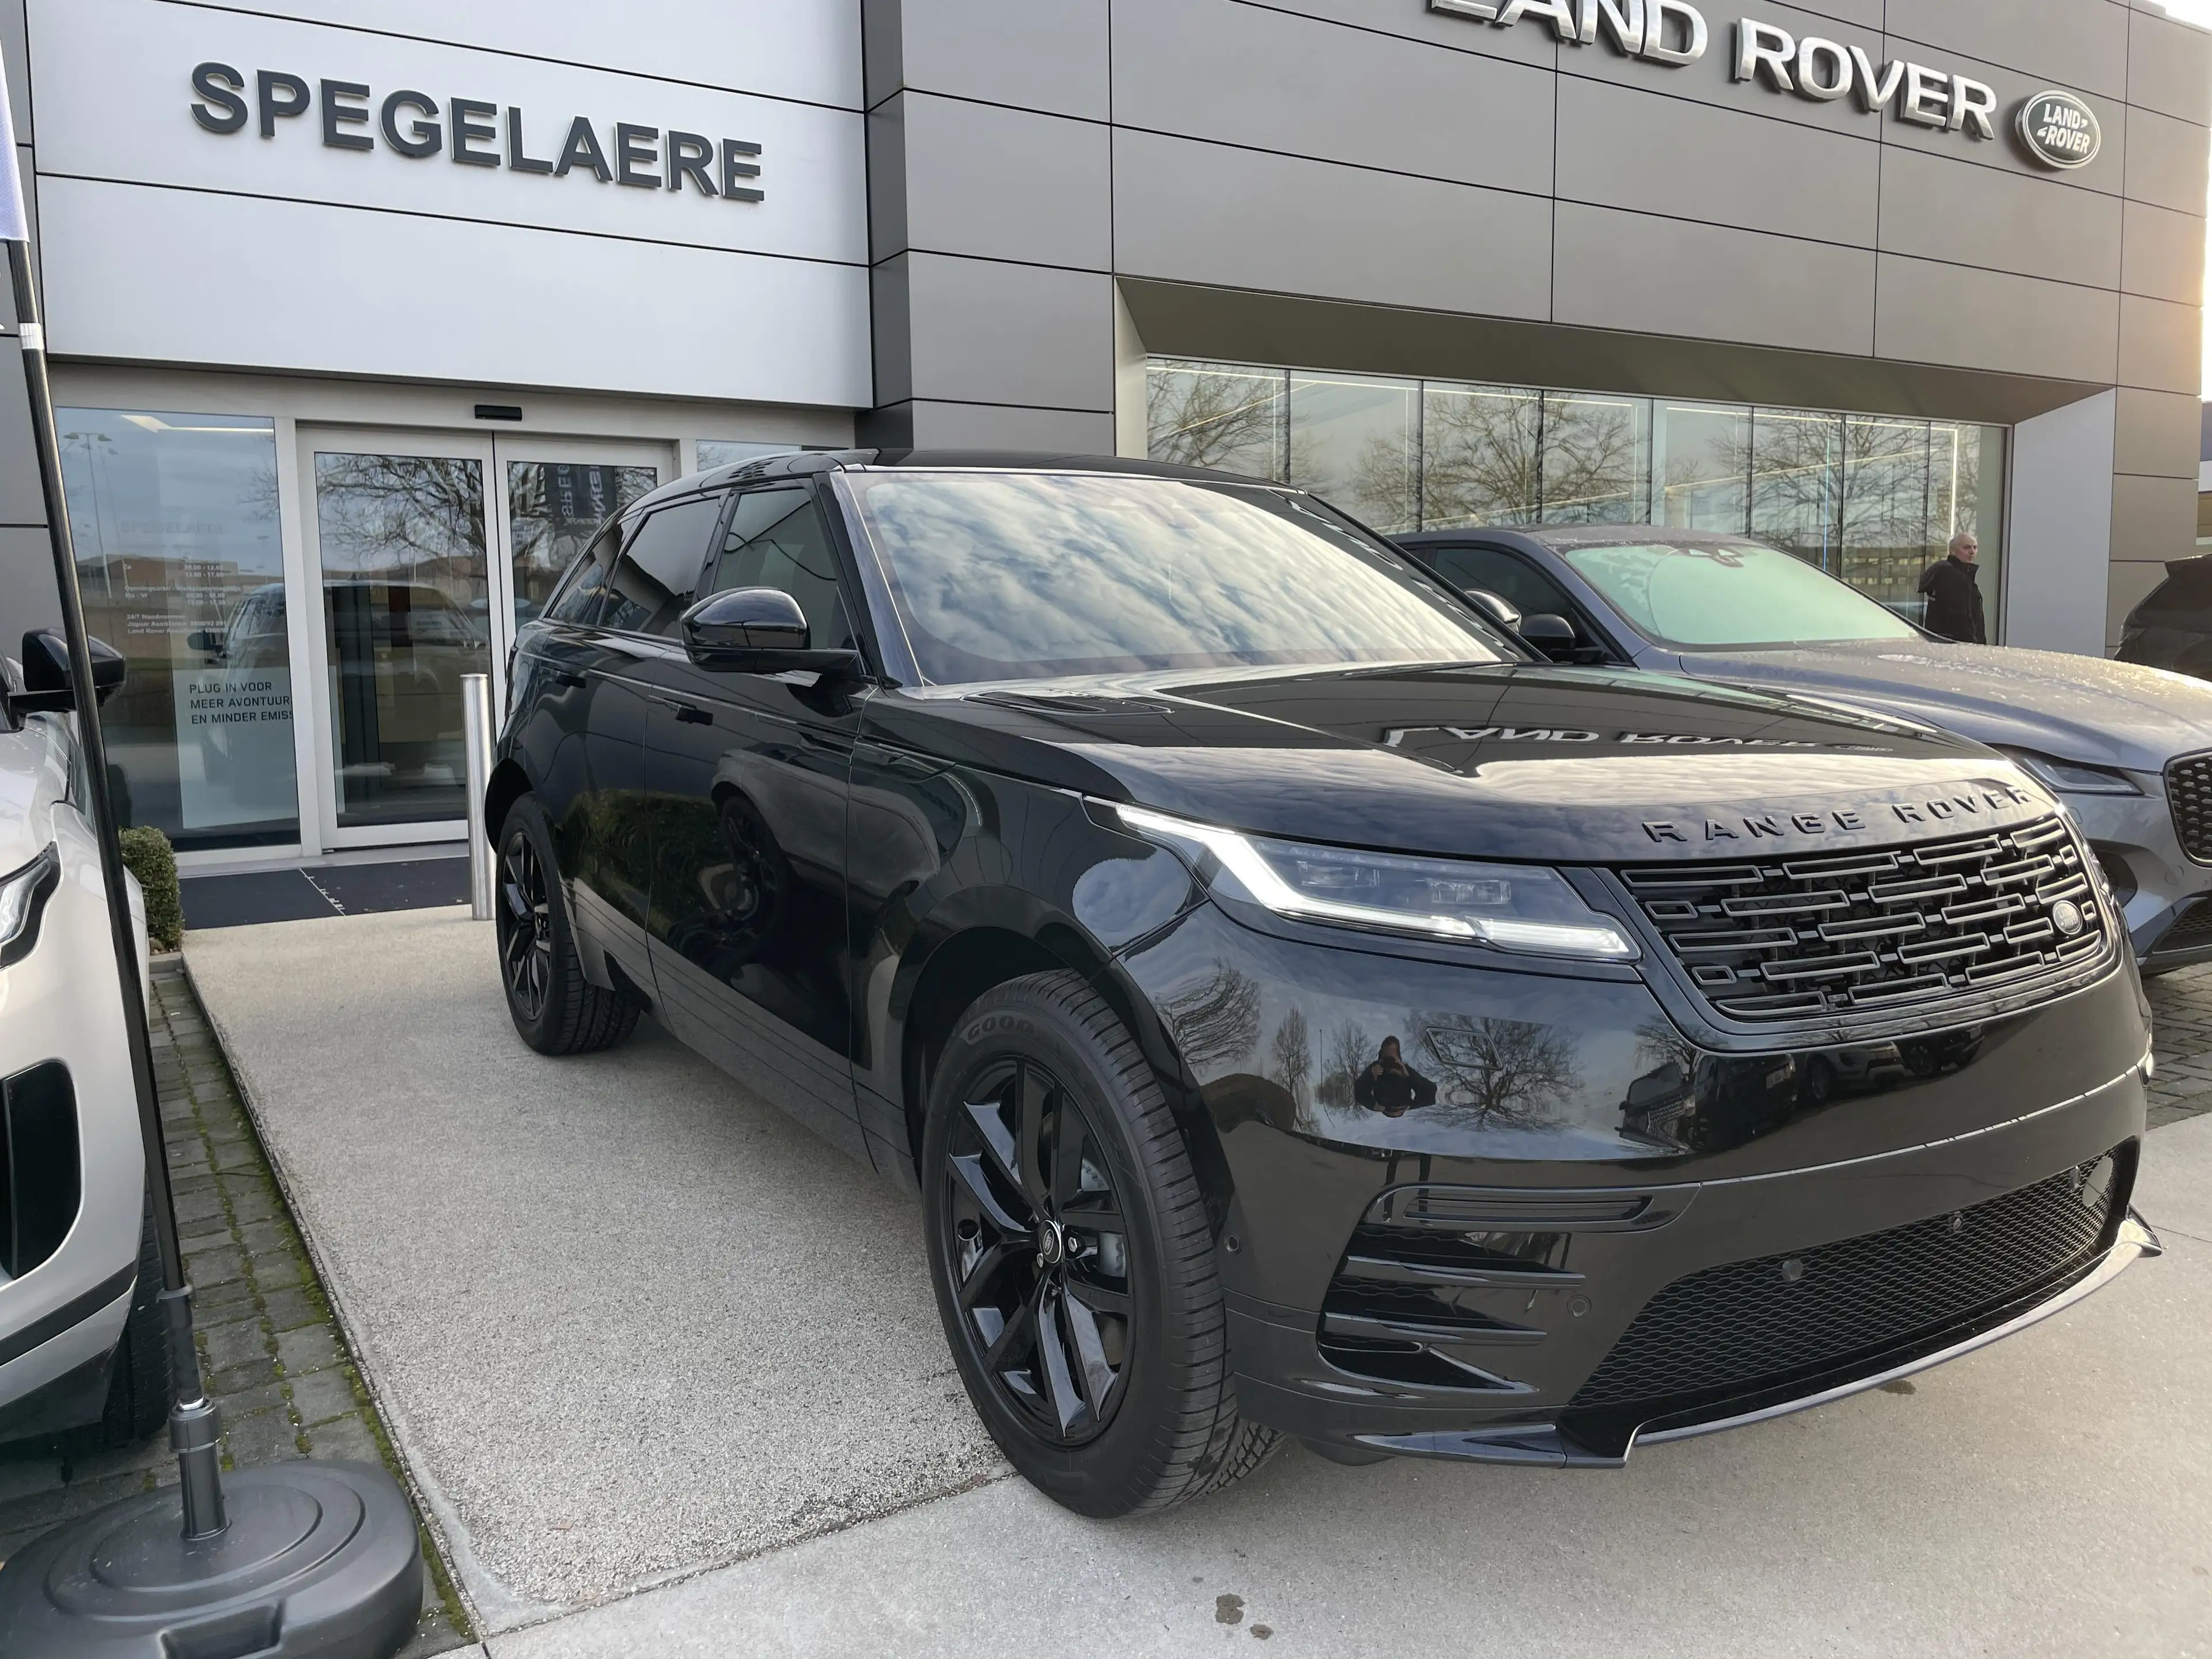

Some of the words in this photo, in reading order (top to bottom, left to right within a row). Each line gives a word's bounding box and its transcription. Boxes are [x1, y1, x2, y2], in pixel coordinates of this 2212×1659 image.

[1735, 17, 1997, 141] ROVER
[2043, 103, 2081, 130] LAND
[190, 61, 766, 202] SPEGELAERE
[2045, 125, 2090, 154] ROVER
[190, 683, 221, 694] PLUG
[225, 683, 237, 692] IN
[240, 681, 272, 691] VOOR
[191, 698, 224, 709] MEER
[229, 696, 290, 707] AVONTUUR
[191, 714, 207, 724] EN
[211, 712, 257, 724] MINDER
[1642, 810, 1867, 843] RANGE
[1891, 783, 2033, 823] ROVER
